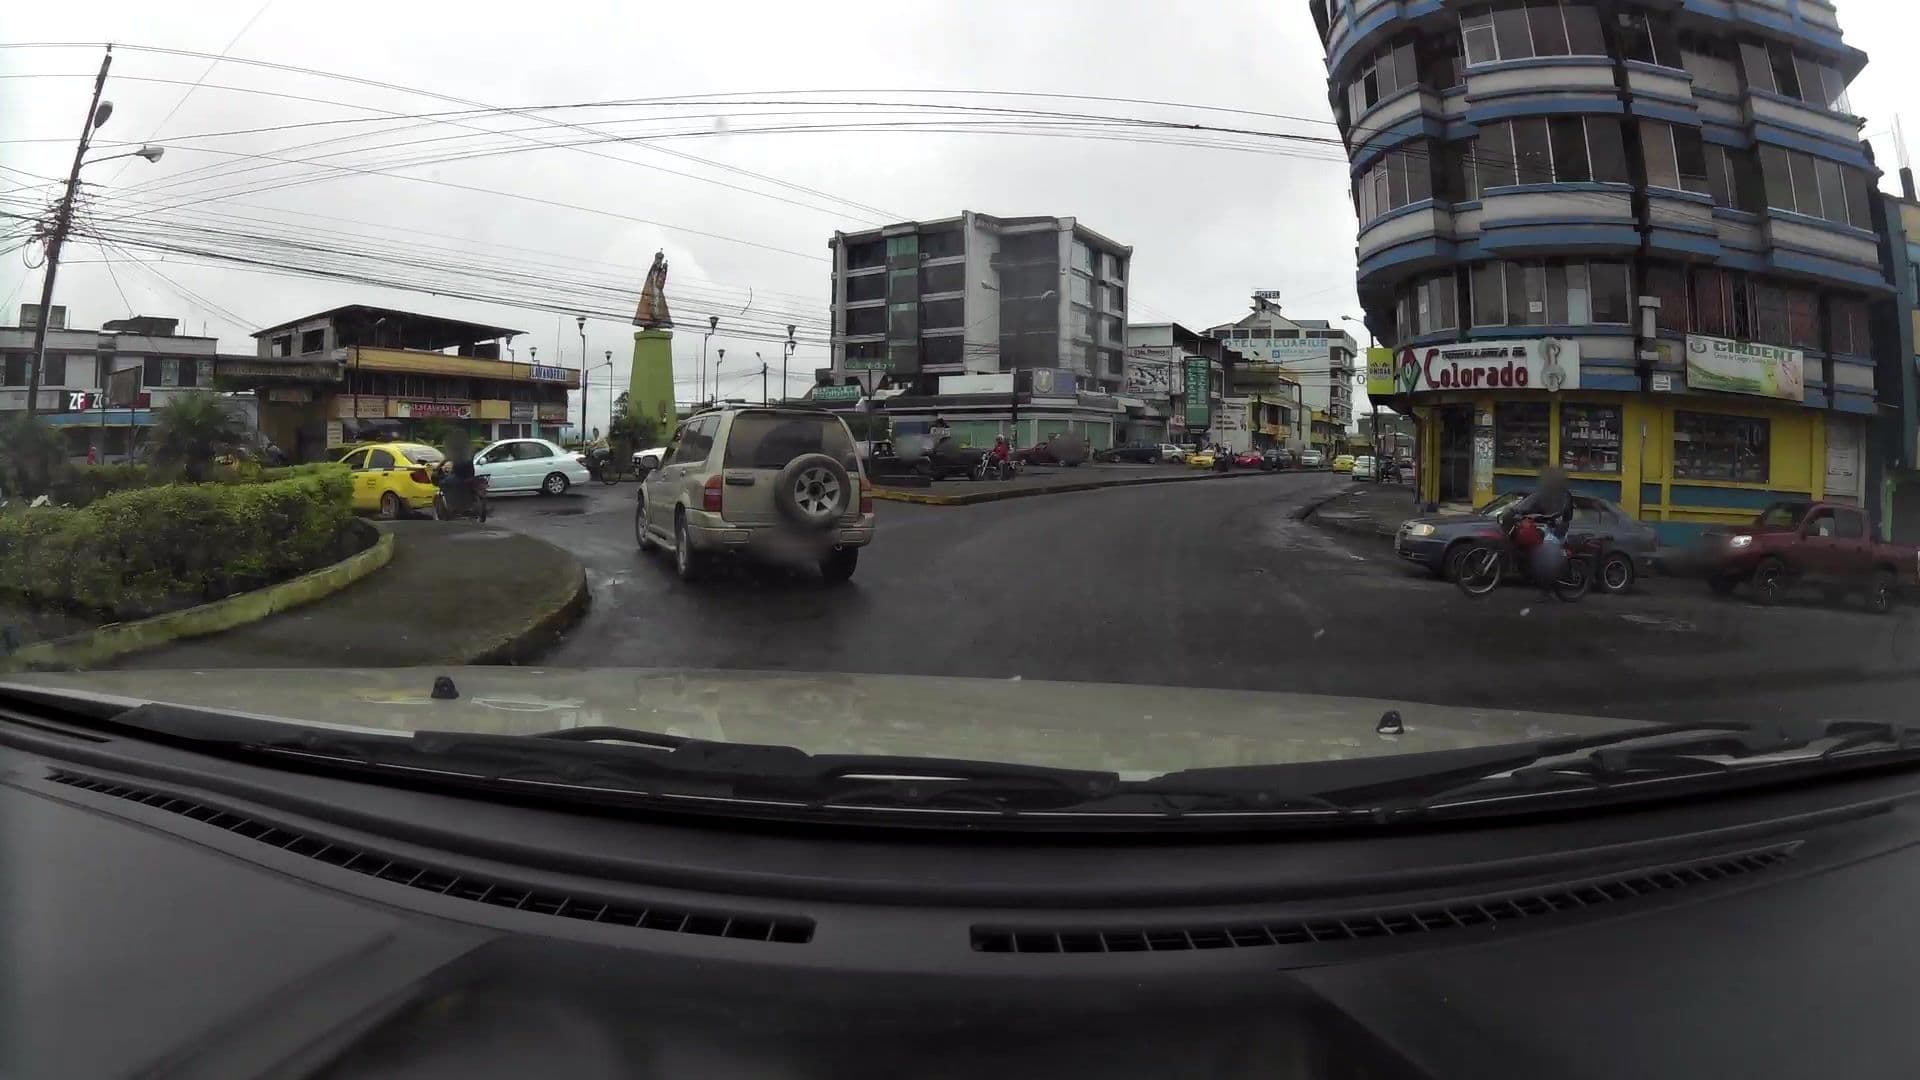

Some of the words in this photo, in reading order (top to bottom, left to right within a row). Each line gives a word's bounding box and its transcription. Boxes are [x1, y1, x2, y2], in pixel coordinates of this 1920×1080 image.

[1255, 291, 1280, 299] HOTEL
[1223, 339, 1257, 348] OTEL
[1713, 340, 1794, 362] CIRDENT
[1424, 348, 1529, 389] Colorado
